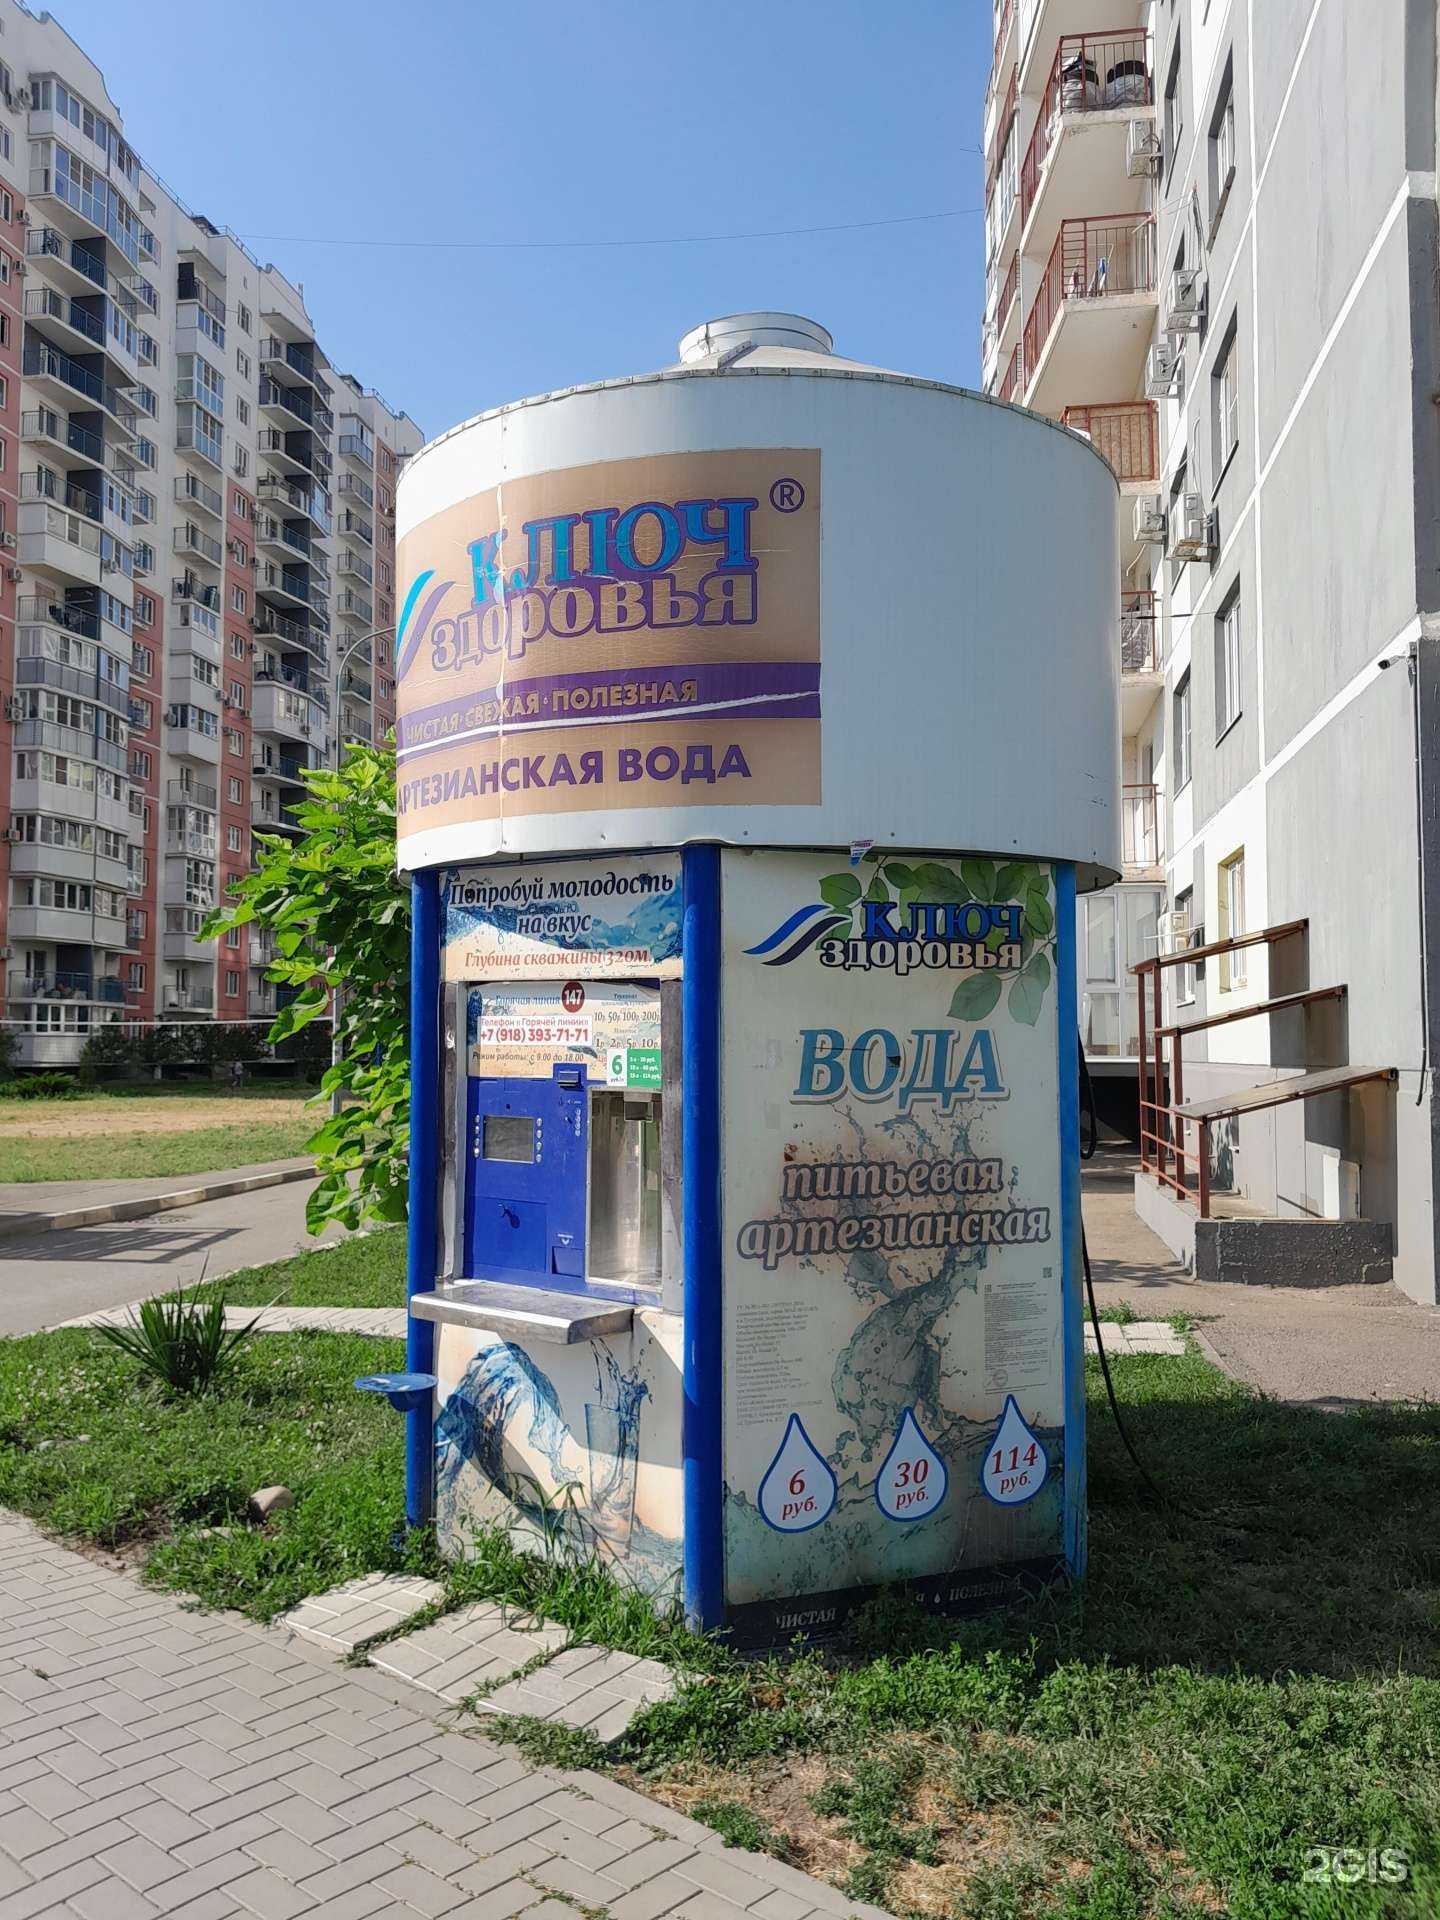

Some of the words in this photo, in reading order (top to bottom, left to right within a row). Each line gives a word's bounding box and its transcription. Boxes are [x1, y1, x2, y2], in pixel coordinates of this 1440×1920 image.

[407, 712, 460, 745] ЧИСТАЯ
[552, 678, 699, 712] ПОЛЕЗНАЯ
[618, 744, 752, 785] ВОДА
[450, 877, 543, 909] Попробуй
[548, 871, 674, 899] молодость
[518, 915, 542, 935] на
[546, 913, 592, 940] вкус
[862, 901, 1026, 942] КЛЮЧ
[465, 951, 520, 972] Глубина
[524, 950, 601, 967] скважины
[565, 989, 582, 1005] 147
[480, 1029, 494, 1041] +7
[496, 1028, 526, 1043] (918)
[528, 1028, 589, 1042] 393-71-71
[611, 1054, 623, 1075] 6
[790, 1028, 1010, 1118] ВОДА
[782, 1157, 1006, 1201] питьевая
[737, 1206, 1051, 1271] артезианская
[990, 1442, 1039, 1476] 114
[789, 1469, 806, 1496] 6
[894, 1458, 930, 1488] 30
[999, 1472, 1032, 1495] руб.
[781, 1498, 819, 1521] руб.
[895, 1487, 930, 1510] руб.
[776, 1607, 837, 1630] ЧИСТАЯ
